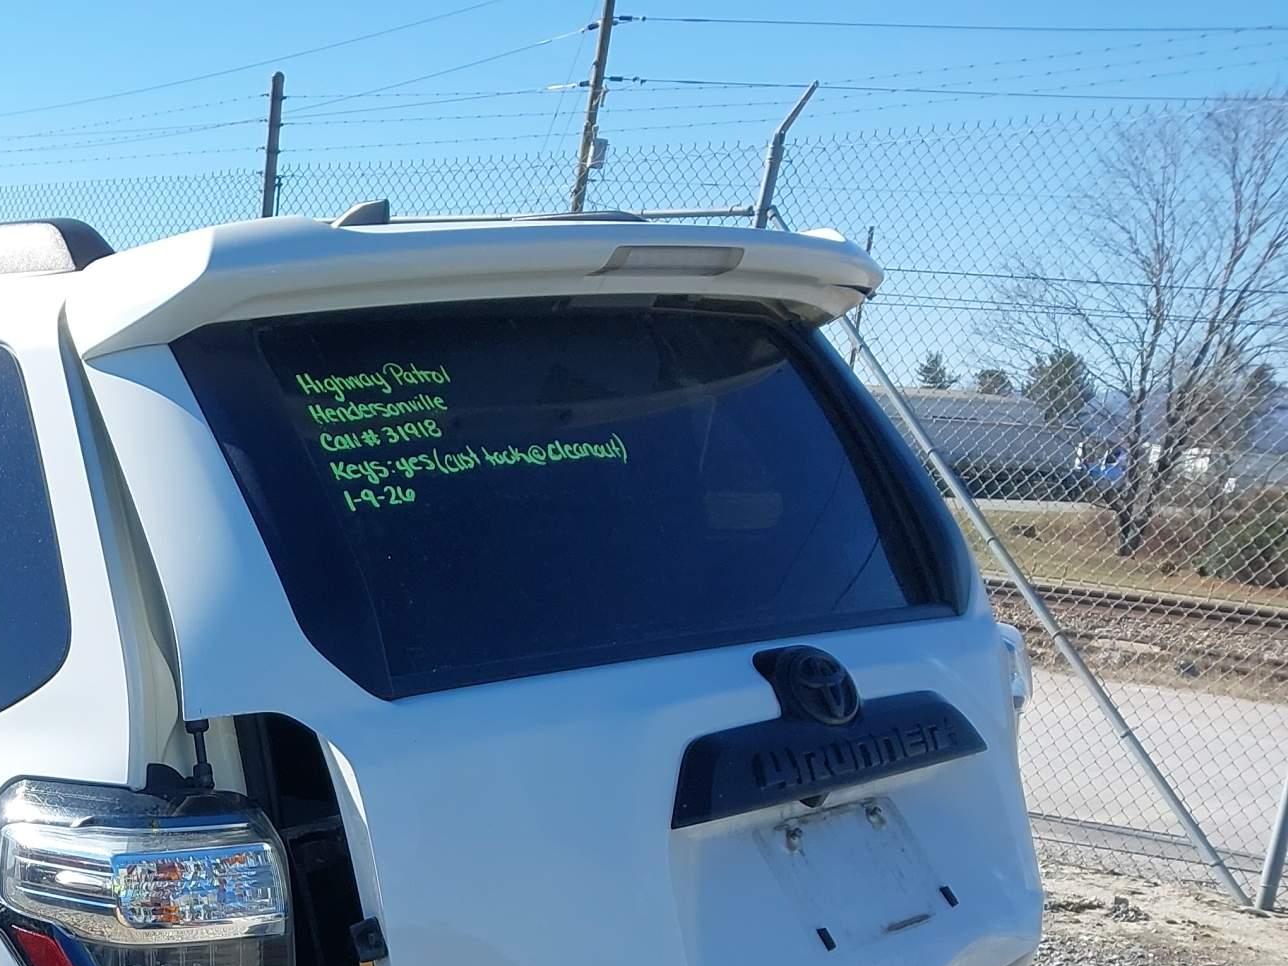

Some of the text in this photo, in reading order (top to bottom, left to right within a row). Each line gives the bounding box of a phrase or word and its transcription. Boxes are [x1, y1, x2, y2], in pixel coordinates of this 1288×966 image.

[296, 362, 451, 402] Highway Patrol
[308, 393, 448, 425] Hendersonville
[381, 419, 443, 443] 31918
[343, 485, 416, 512] 1-9-26
